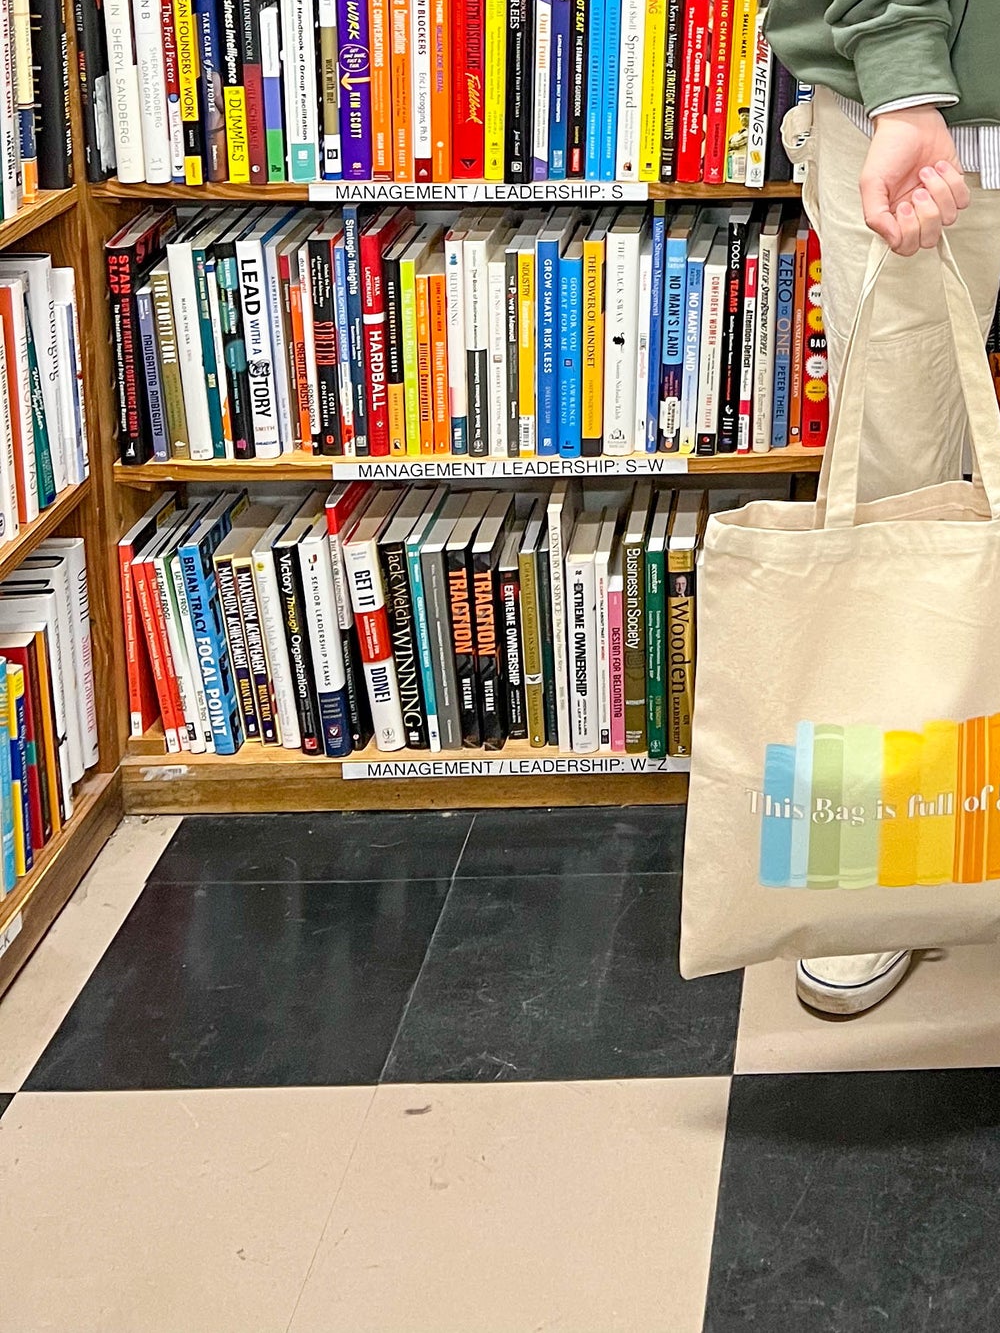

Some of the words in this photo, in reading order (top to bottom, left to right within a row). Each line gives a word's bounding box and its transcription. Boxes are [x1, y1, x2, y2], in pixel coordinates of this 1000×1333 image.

[418, 9, 427, 55] BLOCKERS
[336, 186, 468, 200] MANAGEMENT
[474, 187, 479, 199] /
[484, 186, 605, 199] LEADERSHIP:
[612, 186, 623, 199] S
[241, 259, 260, 315] LEAD
[369, 330, 386, 412] HARDBALL
[776, 397, 784, 419] THIEL
[358, 463, 488, 478] MANAGEMENT
[492, 461, 498, 476] /
[505, 460, 620, 475] LEADERSHIP:
[183, 557, 197, 590] BRIAN
[190, 593, 206, 633] TRACY
[449, 568, 472, 654] TRACTION
[474, 570, 496, 655] TRACTION
[504, 584, 516, 627] EXTREME
[574, 583, 585, 629] EXTREME
[196, 636, 214, 687] FOCAL
[506, 629, 519, 685] OWNERSHIP
[577, 632, 587, 697] OWNERSHIP
[671, 600, 691, 695] Wooden
[395, 631, 421, 728] WINNING
[207, 690, 227, 737] POINT
[367, 762, 493, 776] MANAGEMENT
[499, 761, 504, 774] /
[509, 759, 624, 773] LEADERSHIP:
[745, 788, 805, 820] This
[812, 798, 865, 824] Bag
[876, 801, 896, 821] is
[908, 793, 954, 818] full
[964, 786, 993, 812] of
